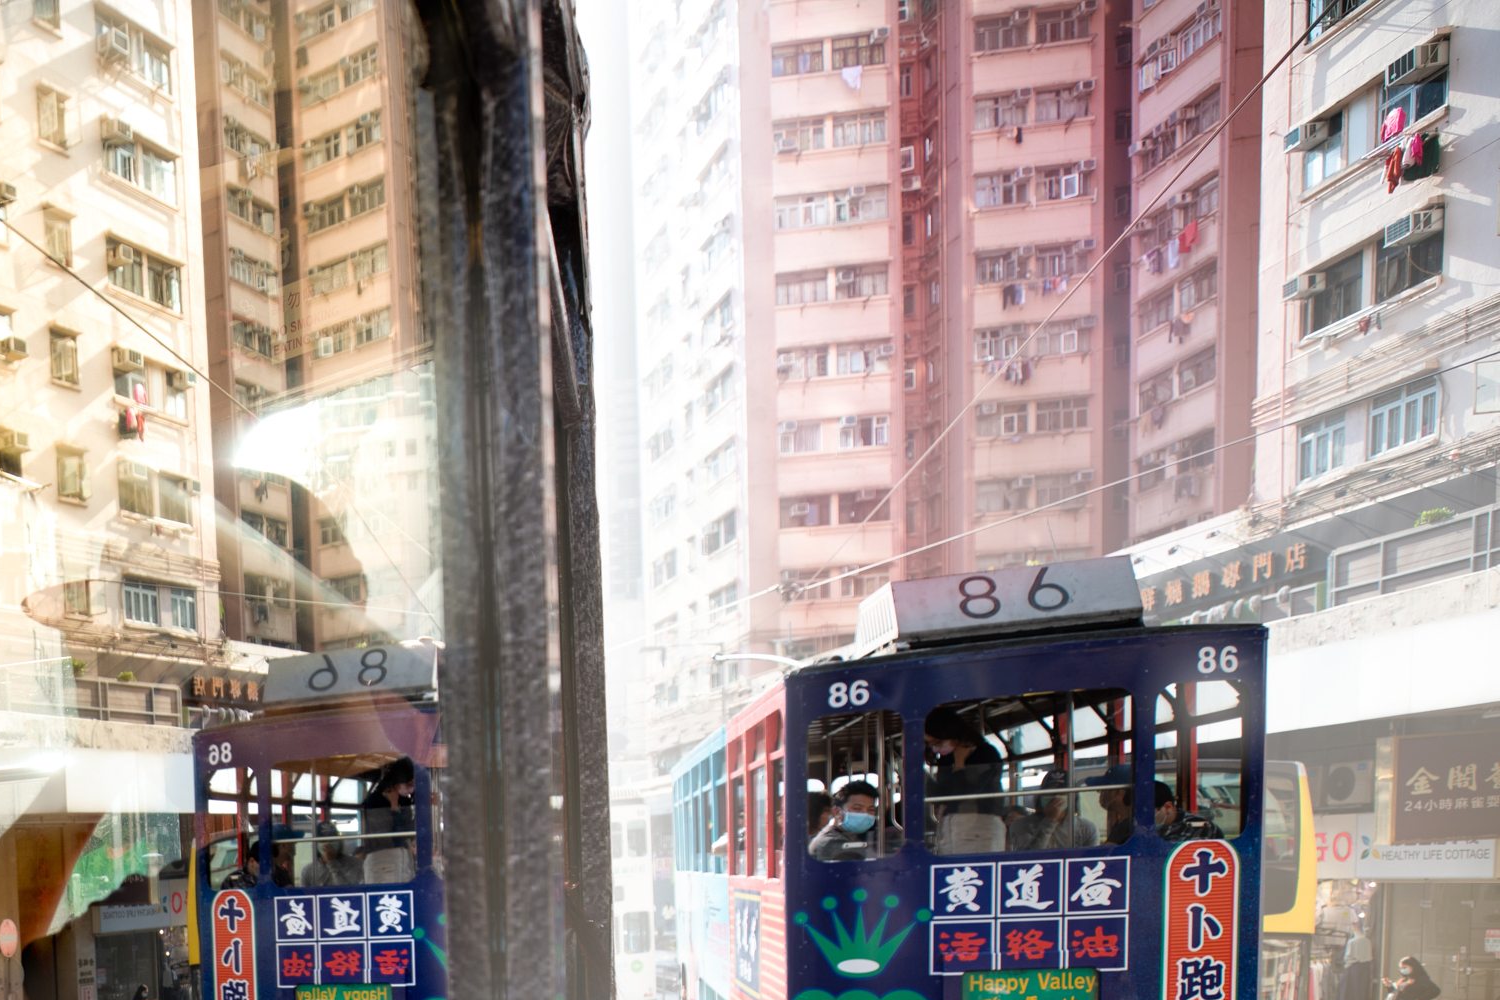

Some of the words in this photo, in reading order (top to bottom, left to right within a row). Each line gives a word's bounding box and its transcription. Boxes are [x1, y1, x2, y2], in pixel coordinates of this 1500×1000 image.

[290, 305, 340, 333] SMOKING
[274, 333, 311, 356] EATING
[957, 566, 1070, 620] 86
[1196, 645, 1239, 674] 86
[827, 679, 870, 708] 86
[1382, 850, 1419, 861] HEALTHY
[1423, 850, 1442, 860] LIFE
[1445, 849, 1490, 860] COTTAGE
[938, 862, 1122, 913] 黃道益
[937, 926, 1119, 964] 活絡油
[969, 972, 1029, 996] Happy
[1037, 970, 1097, 994] Valley
